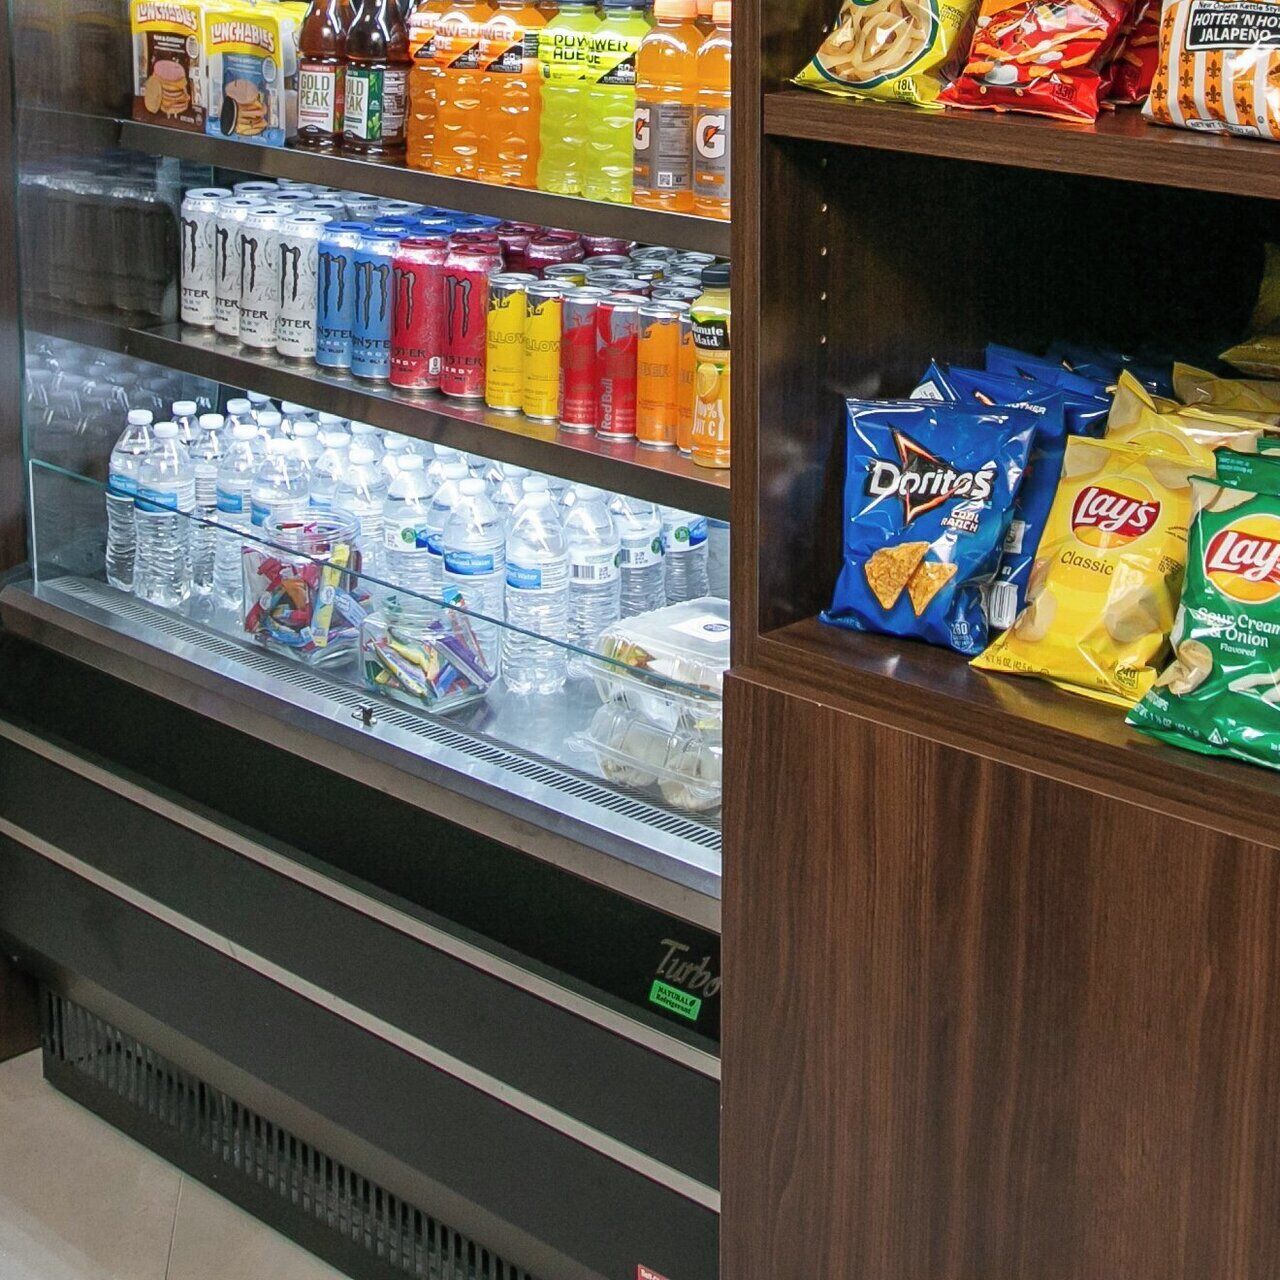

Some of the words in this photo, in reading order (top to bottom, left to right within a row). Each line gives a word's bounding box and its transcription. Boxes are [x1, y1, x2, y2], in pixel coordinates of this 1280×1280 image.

[135, 1, 198, 32] LUNCHABLES
[1239, 2, 1264, 12] Kettle
[1193, 11, 1238, 27] HOTTER
[210, 21, 276, 53] LUNCHABLES
[1199, 25, 1272, 43] JALAPEÑO
[301, 73, 330, 91] GOLD
[300, 90, 330, 107] PEAK
[696, 114, 726, 159] G
[870, 458, 996, 500] Doritos
[950, 508, 980, 523] COOL
[1076, 485, 1159, 536] Lay's
[940, 517, 980, 533] RANCH
[1060, 549, 1115, 576] Classic
[1195, 607, 1235, 629] Sour
[1224, 626, 1270, 648] Onion
[1219, 642, 1257, 658] Flavored
[656, 938, 722, 998] Turbo
[655, 993, 691, 1015] Refrigerant
[657, 985, 690, 1006] NATURAL
